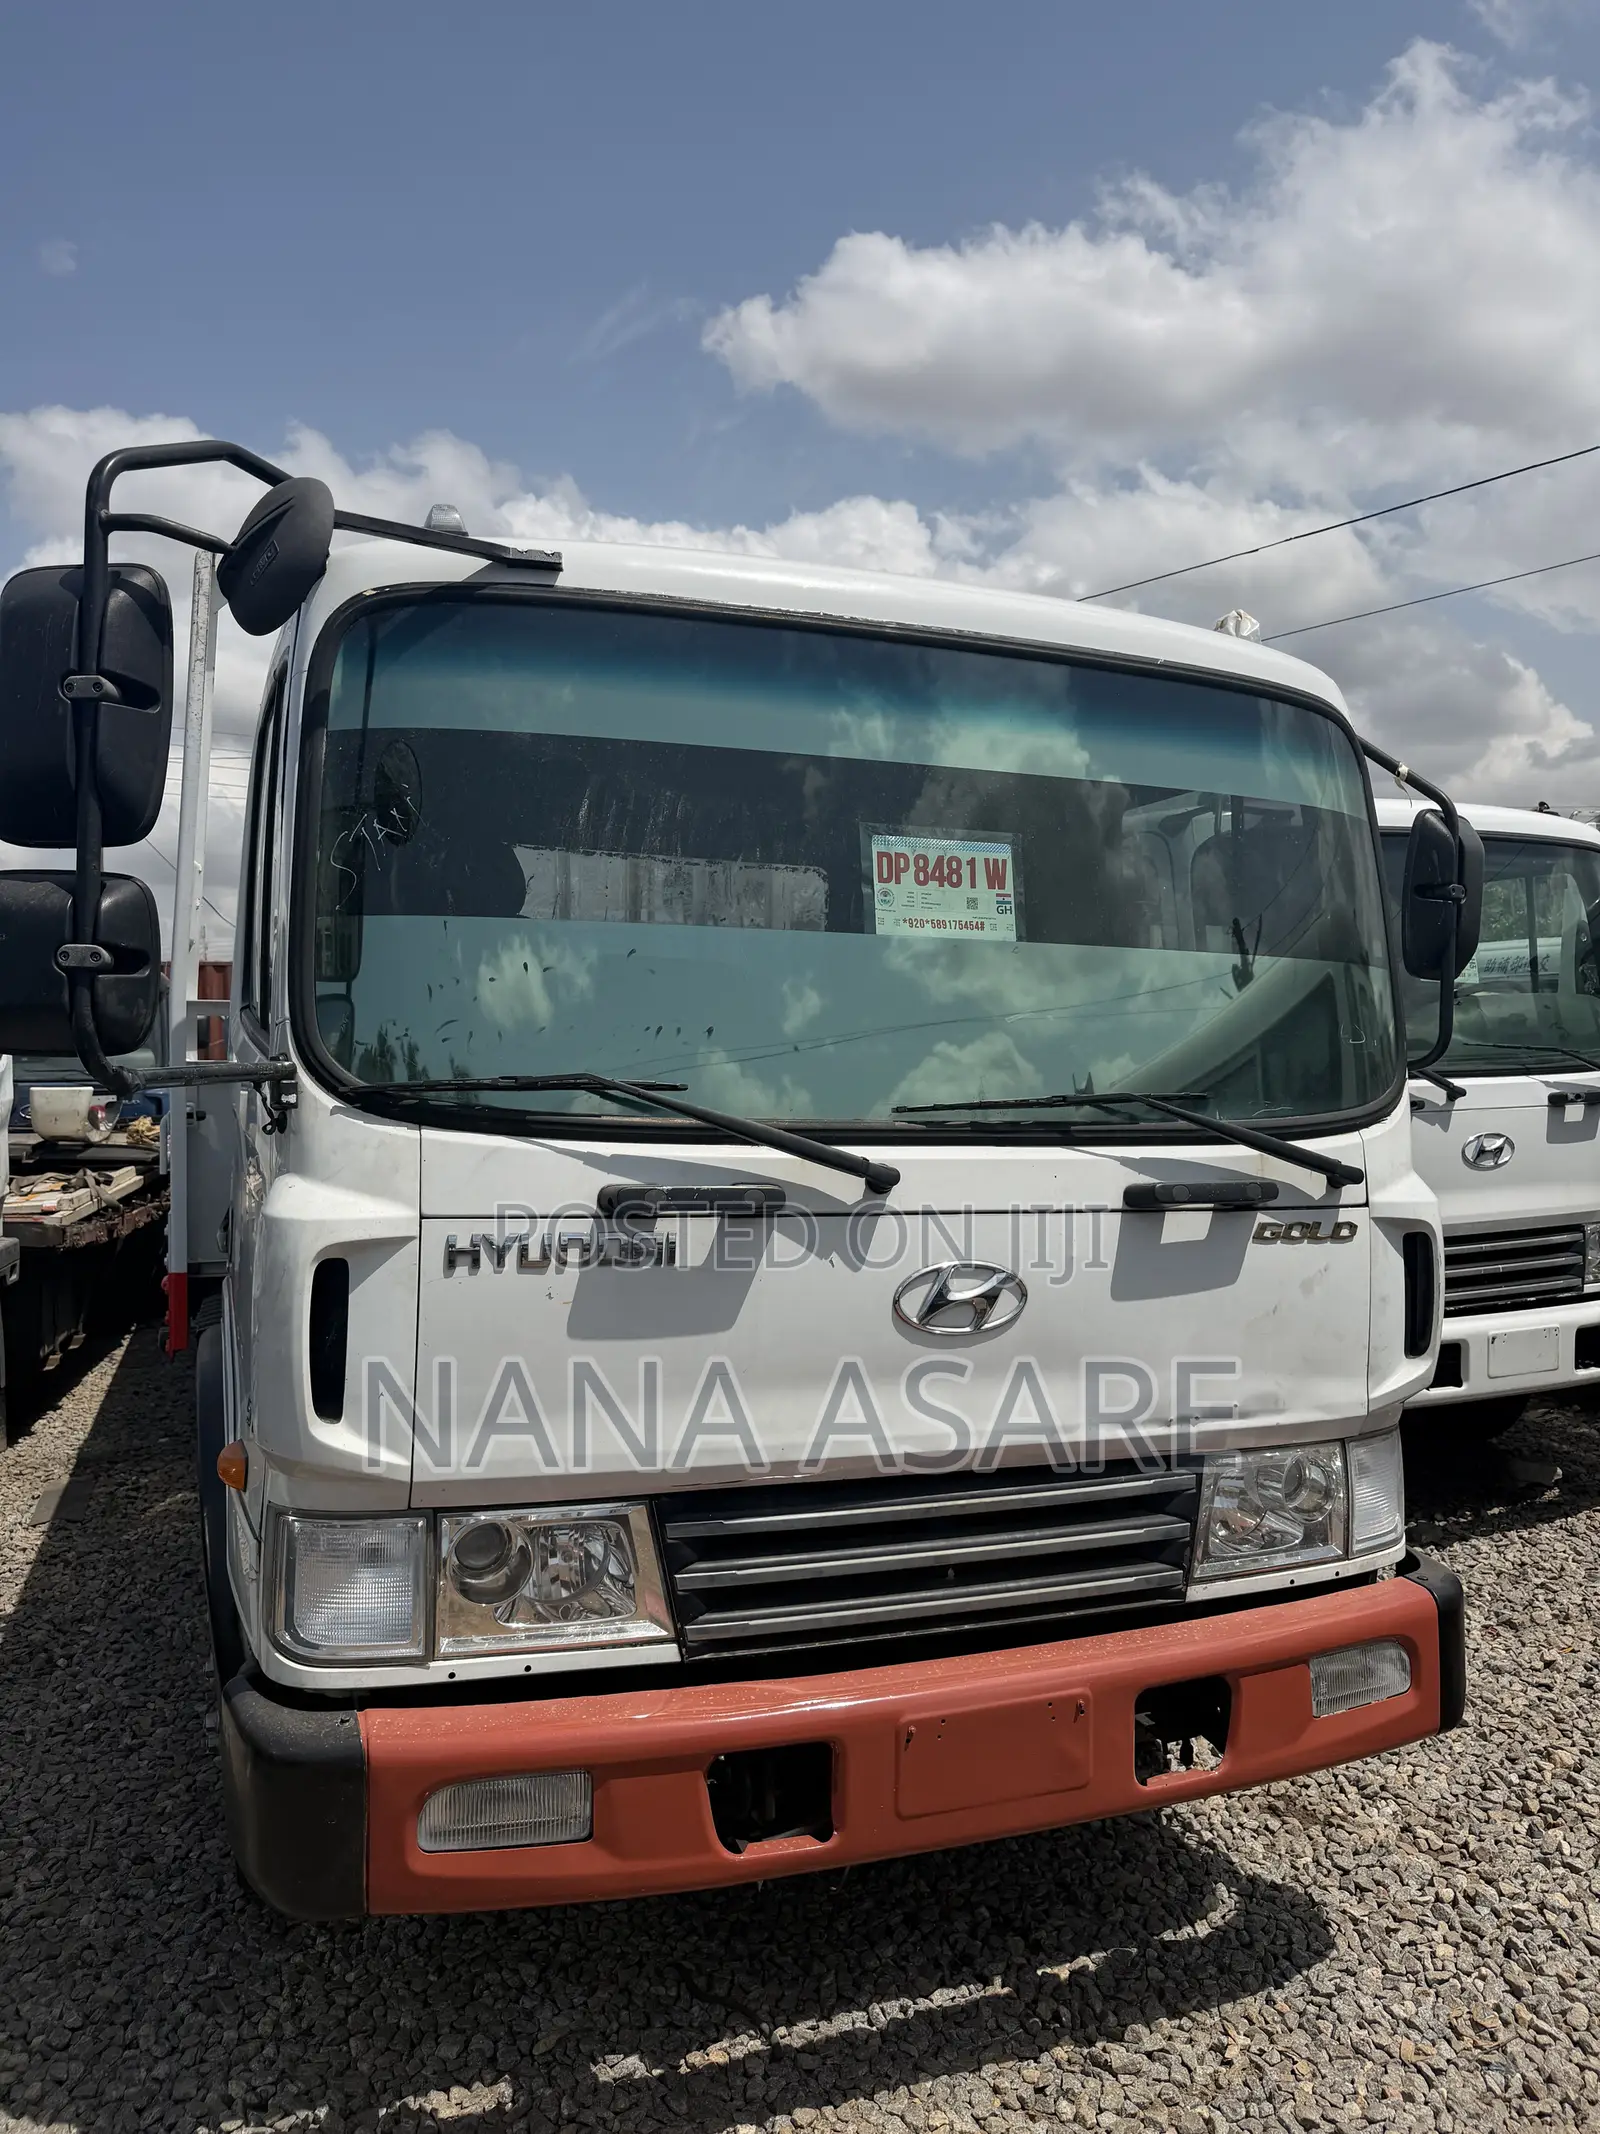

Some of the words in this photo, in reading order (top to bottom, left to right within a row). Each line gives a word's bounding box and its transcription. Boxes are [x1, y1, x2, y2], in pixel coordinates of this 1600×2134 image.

[996, 904, 1013, 915] GH
[1252, 1221, 1359, 1241] GOLD
[445, 1231, 678, 1271] HYUNDAI
